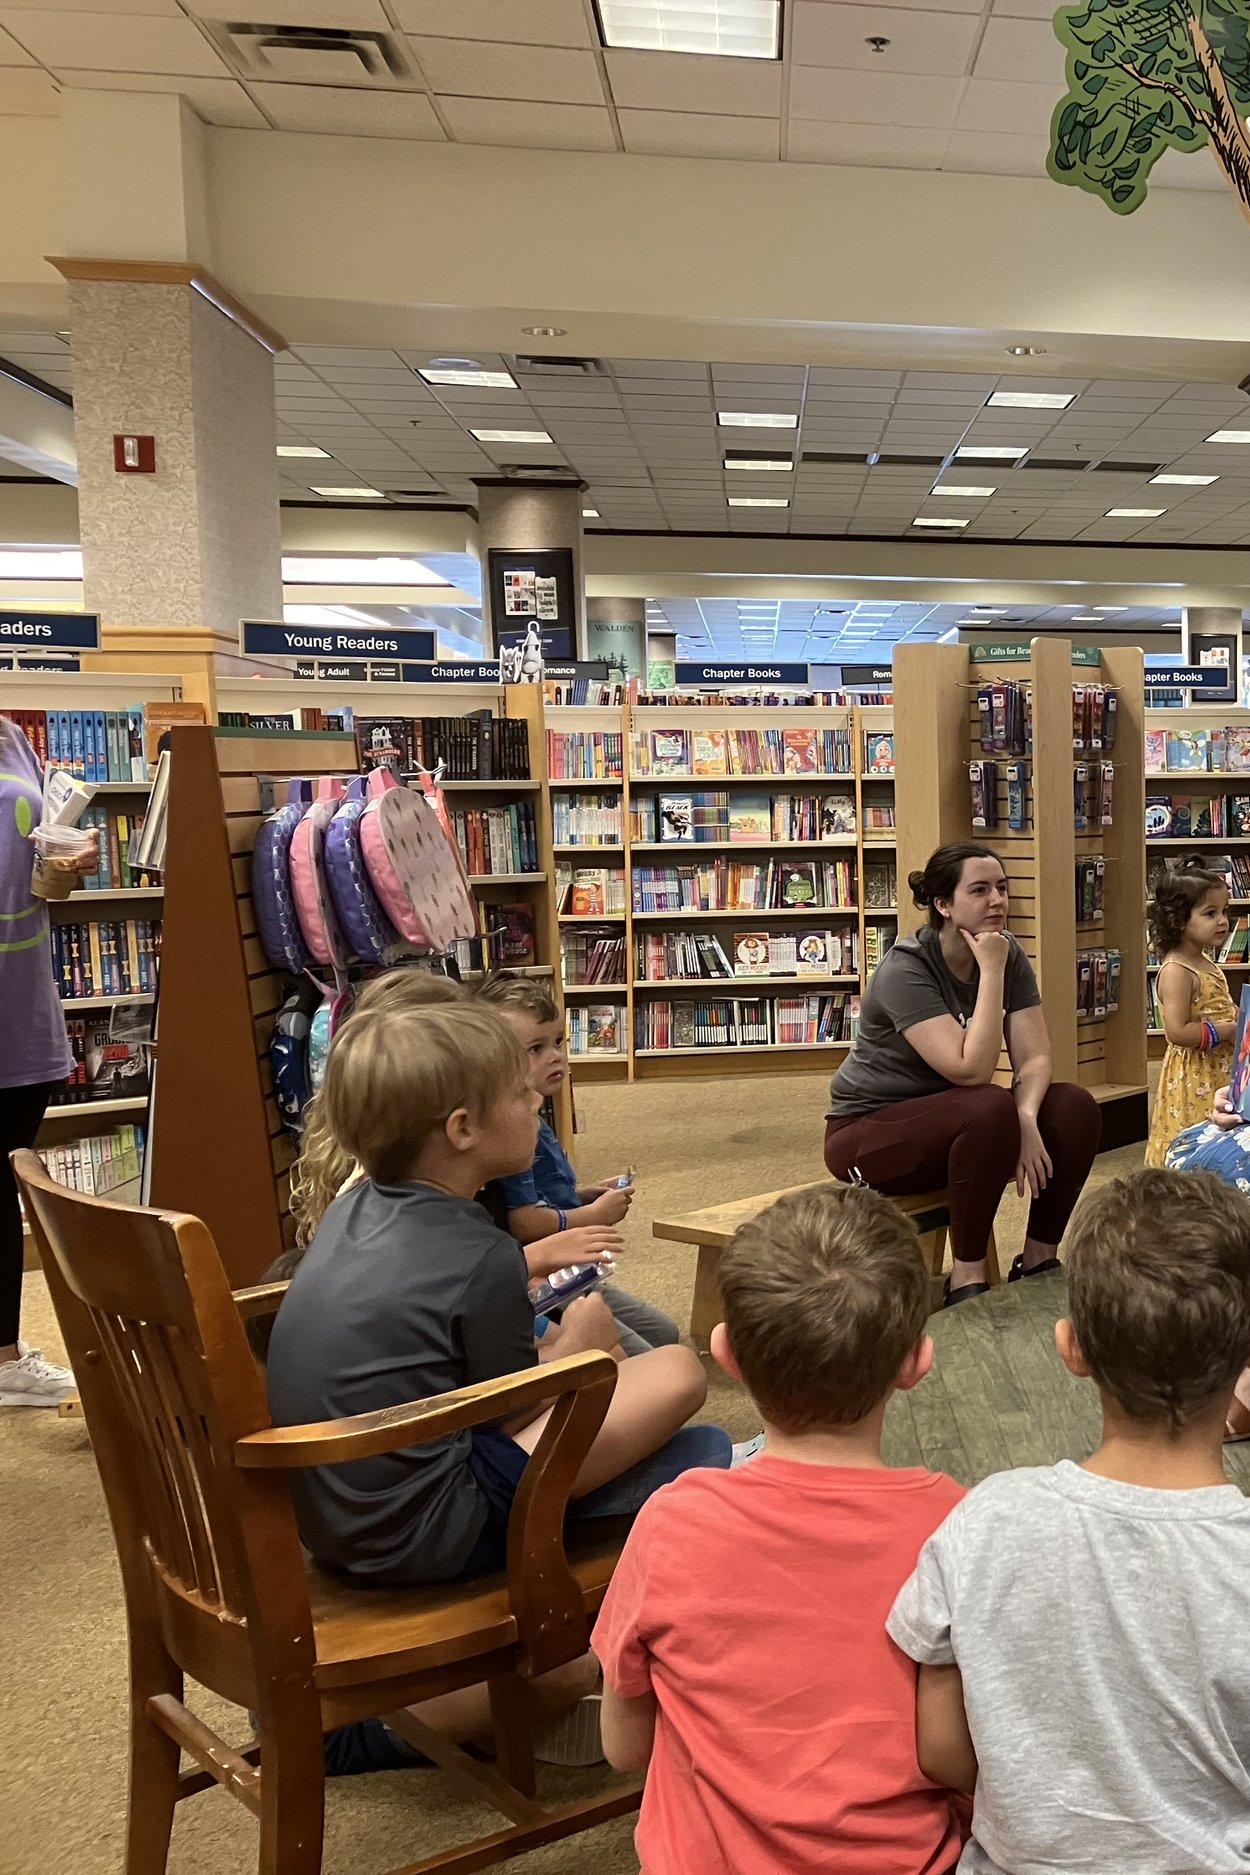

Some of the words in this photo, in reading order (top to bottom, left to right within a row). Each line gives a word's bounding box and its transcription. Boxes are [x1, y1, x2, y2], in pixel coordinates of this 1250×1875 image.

[594, 624, 635, 632] WALDEN
[284, 633, 332, 651] Young
[337, 636, 398, 651] Readers
[990, 647, 1006, 655] Gifts
[1006, 647, 1015, 655] for
[298, 668, 325, 677] Youg
[327, 668, 350, 676] Adult
[431, 667, 476, 677] Chapter
[479, 667, 500, 676] Boo
[703, 669, 745, 679] Chapter
[748, 669, 781, 678] Books
[1145, 673, 1171, 683] apter
[1173, 673, 1203, 681] Books
